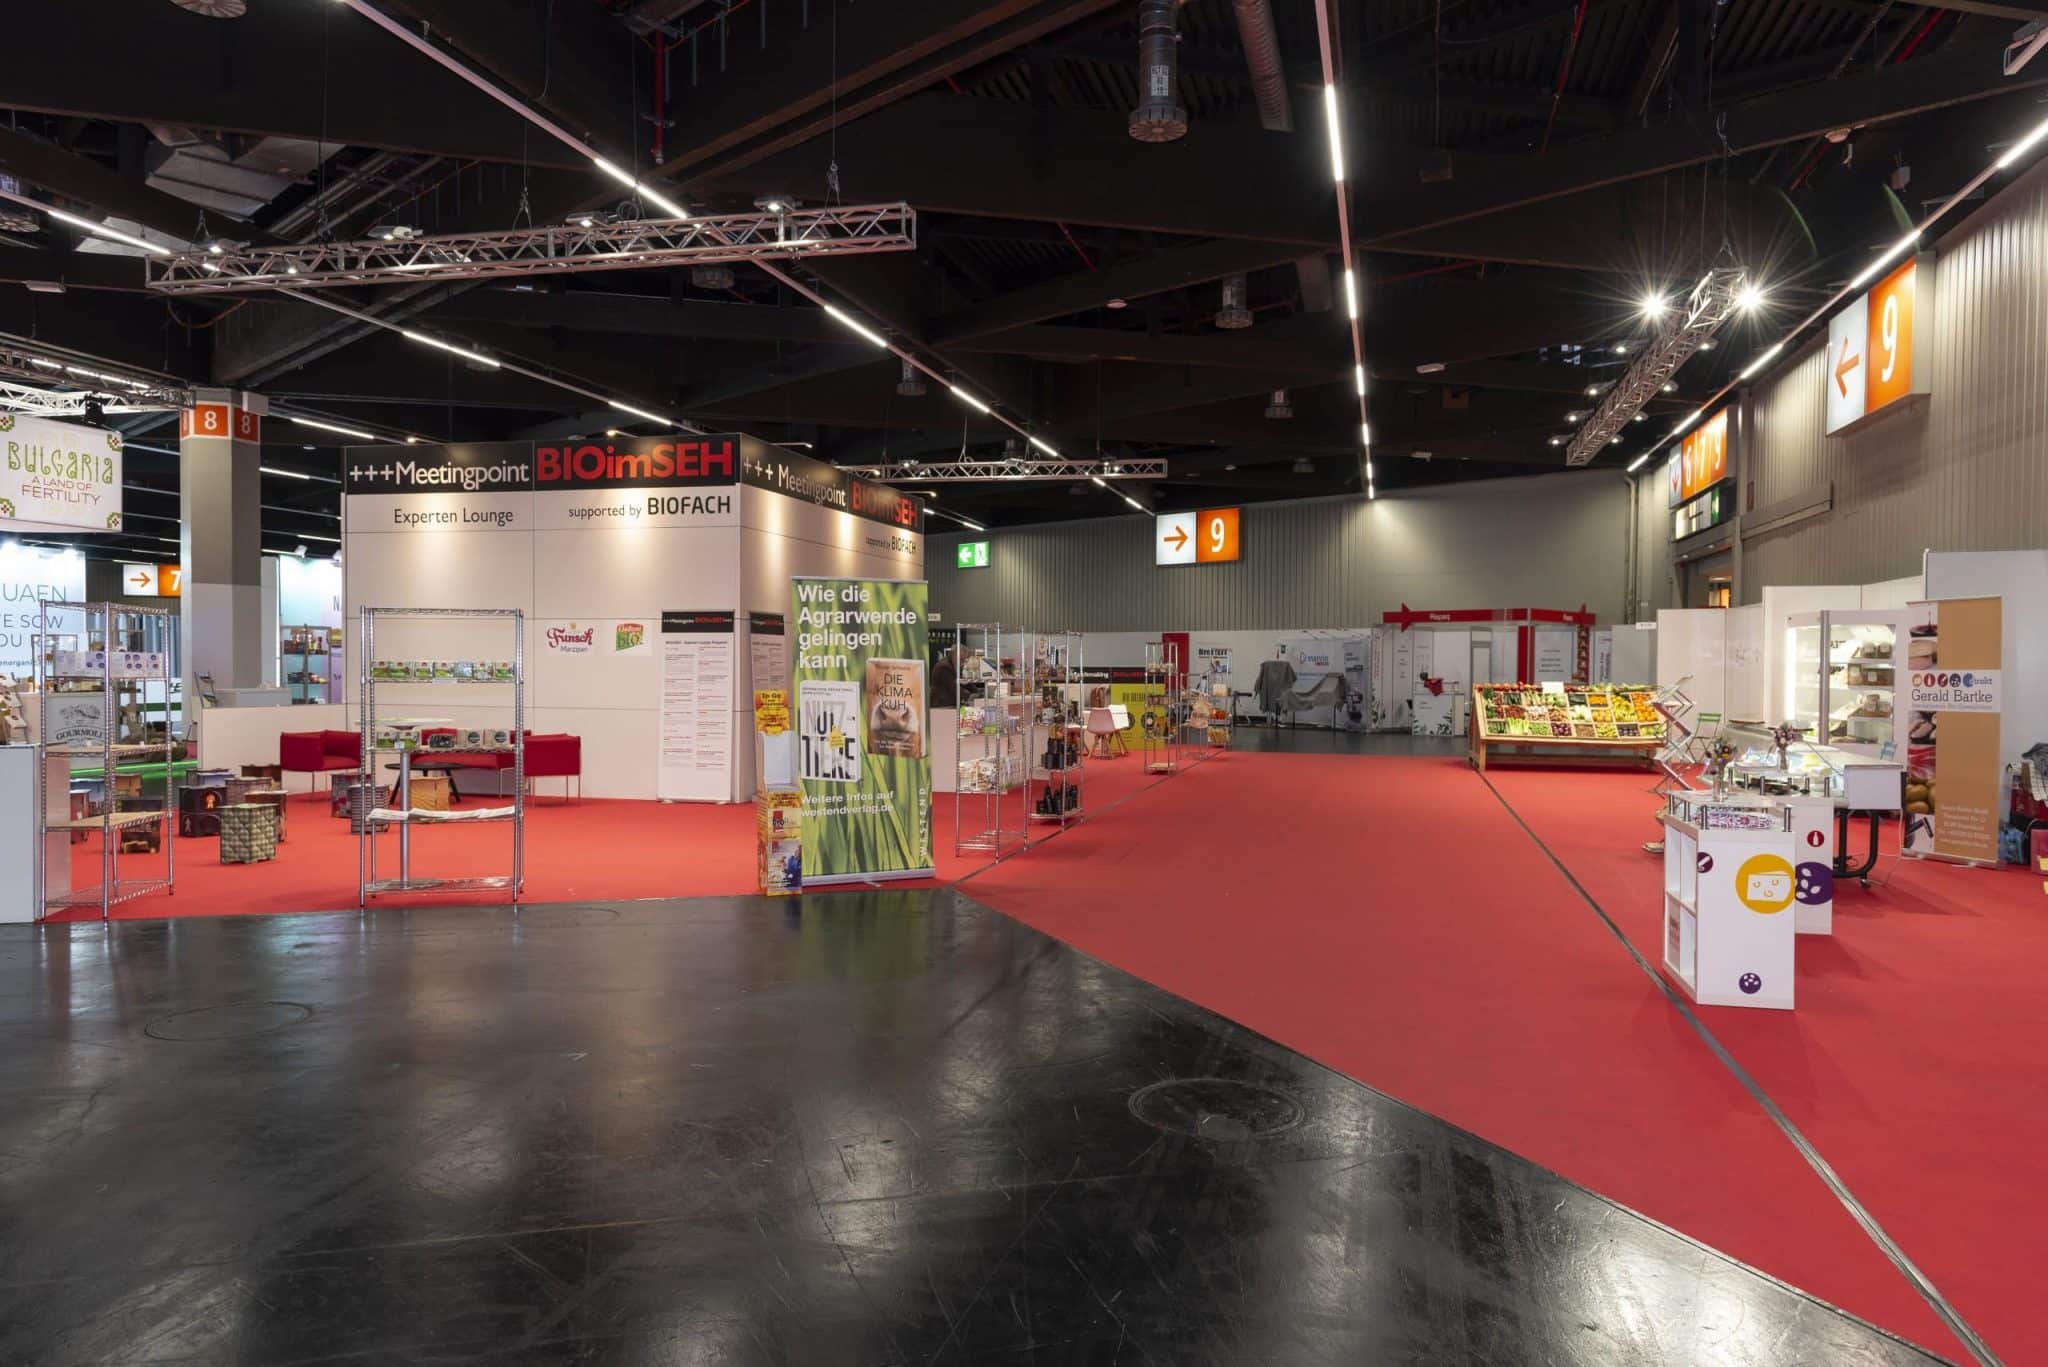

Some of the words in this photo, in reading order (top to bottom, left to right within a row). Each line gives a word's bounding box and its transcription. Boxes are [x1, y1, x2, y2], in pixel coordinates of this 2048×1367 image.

[1881, 294, 1898, 382] 9
[204, 410, 217, 430] 8
[242, 414, 250, 434] 8
[8, 441, 113, 484] BULGARIA
[537, 442, 732, 481] BIOimSEH
[32, 476, 40, 484] A
[43, 478, 74, 489] LAND
[76, 482, 93, 491] OF
[22, 484, 101, 505] FERTILITY
[568, 504, 625, 519] supported
[629, 504, 642, 519] by
[647, 495, 731, 516] BIOFACH
[394, 508, 457, 528] Experten
[463, 507, 514, 527] Lounge
[1210, 518, 1225, 552] 9
[170, 570, 181, 592] 7
[798, 585, 835, 602] Wie
[842, 585, 870, 602] die
[798, 607, 917, 626] Agrarwende
[798, 629, 882, 649] gelingen
[799, 653, 847, 668] kann
[884, 673, 904, 685] DIE
[876, 685, 912, 698] KLIMA
[1911, 688, 1949, 702] Gerald
[1953, 689, 1993, 703] Bartke
[881, 699, 906, 710] KUH
[802, 794, 844, 804] Weitere
[847, 791, 873, 802] Infos
[876, 790, 895, 800] auf
[802, 804, 893, 818] westendverlag.de
